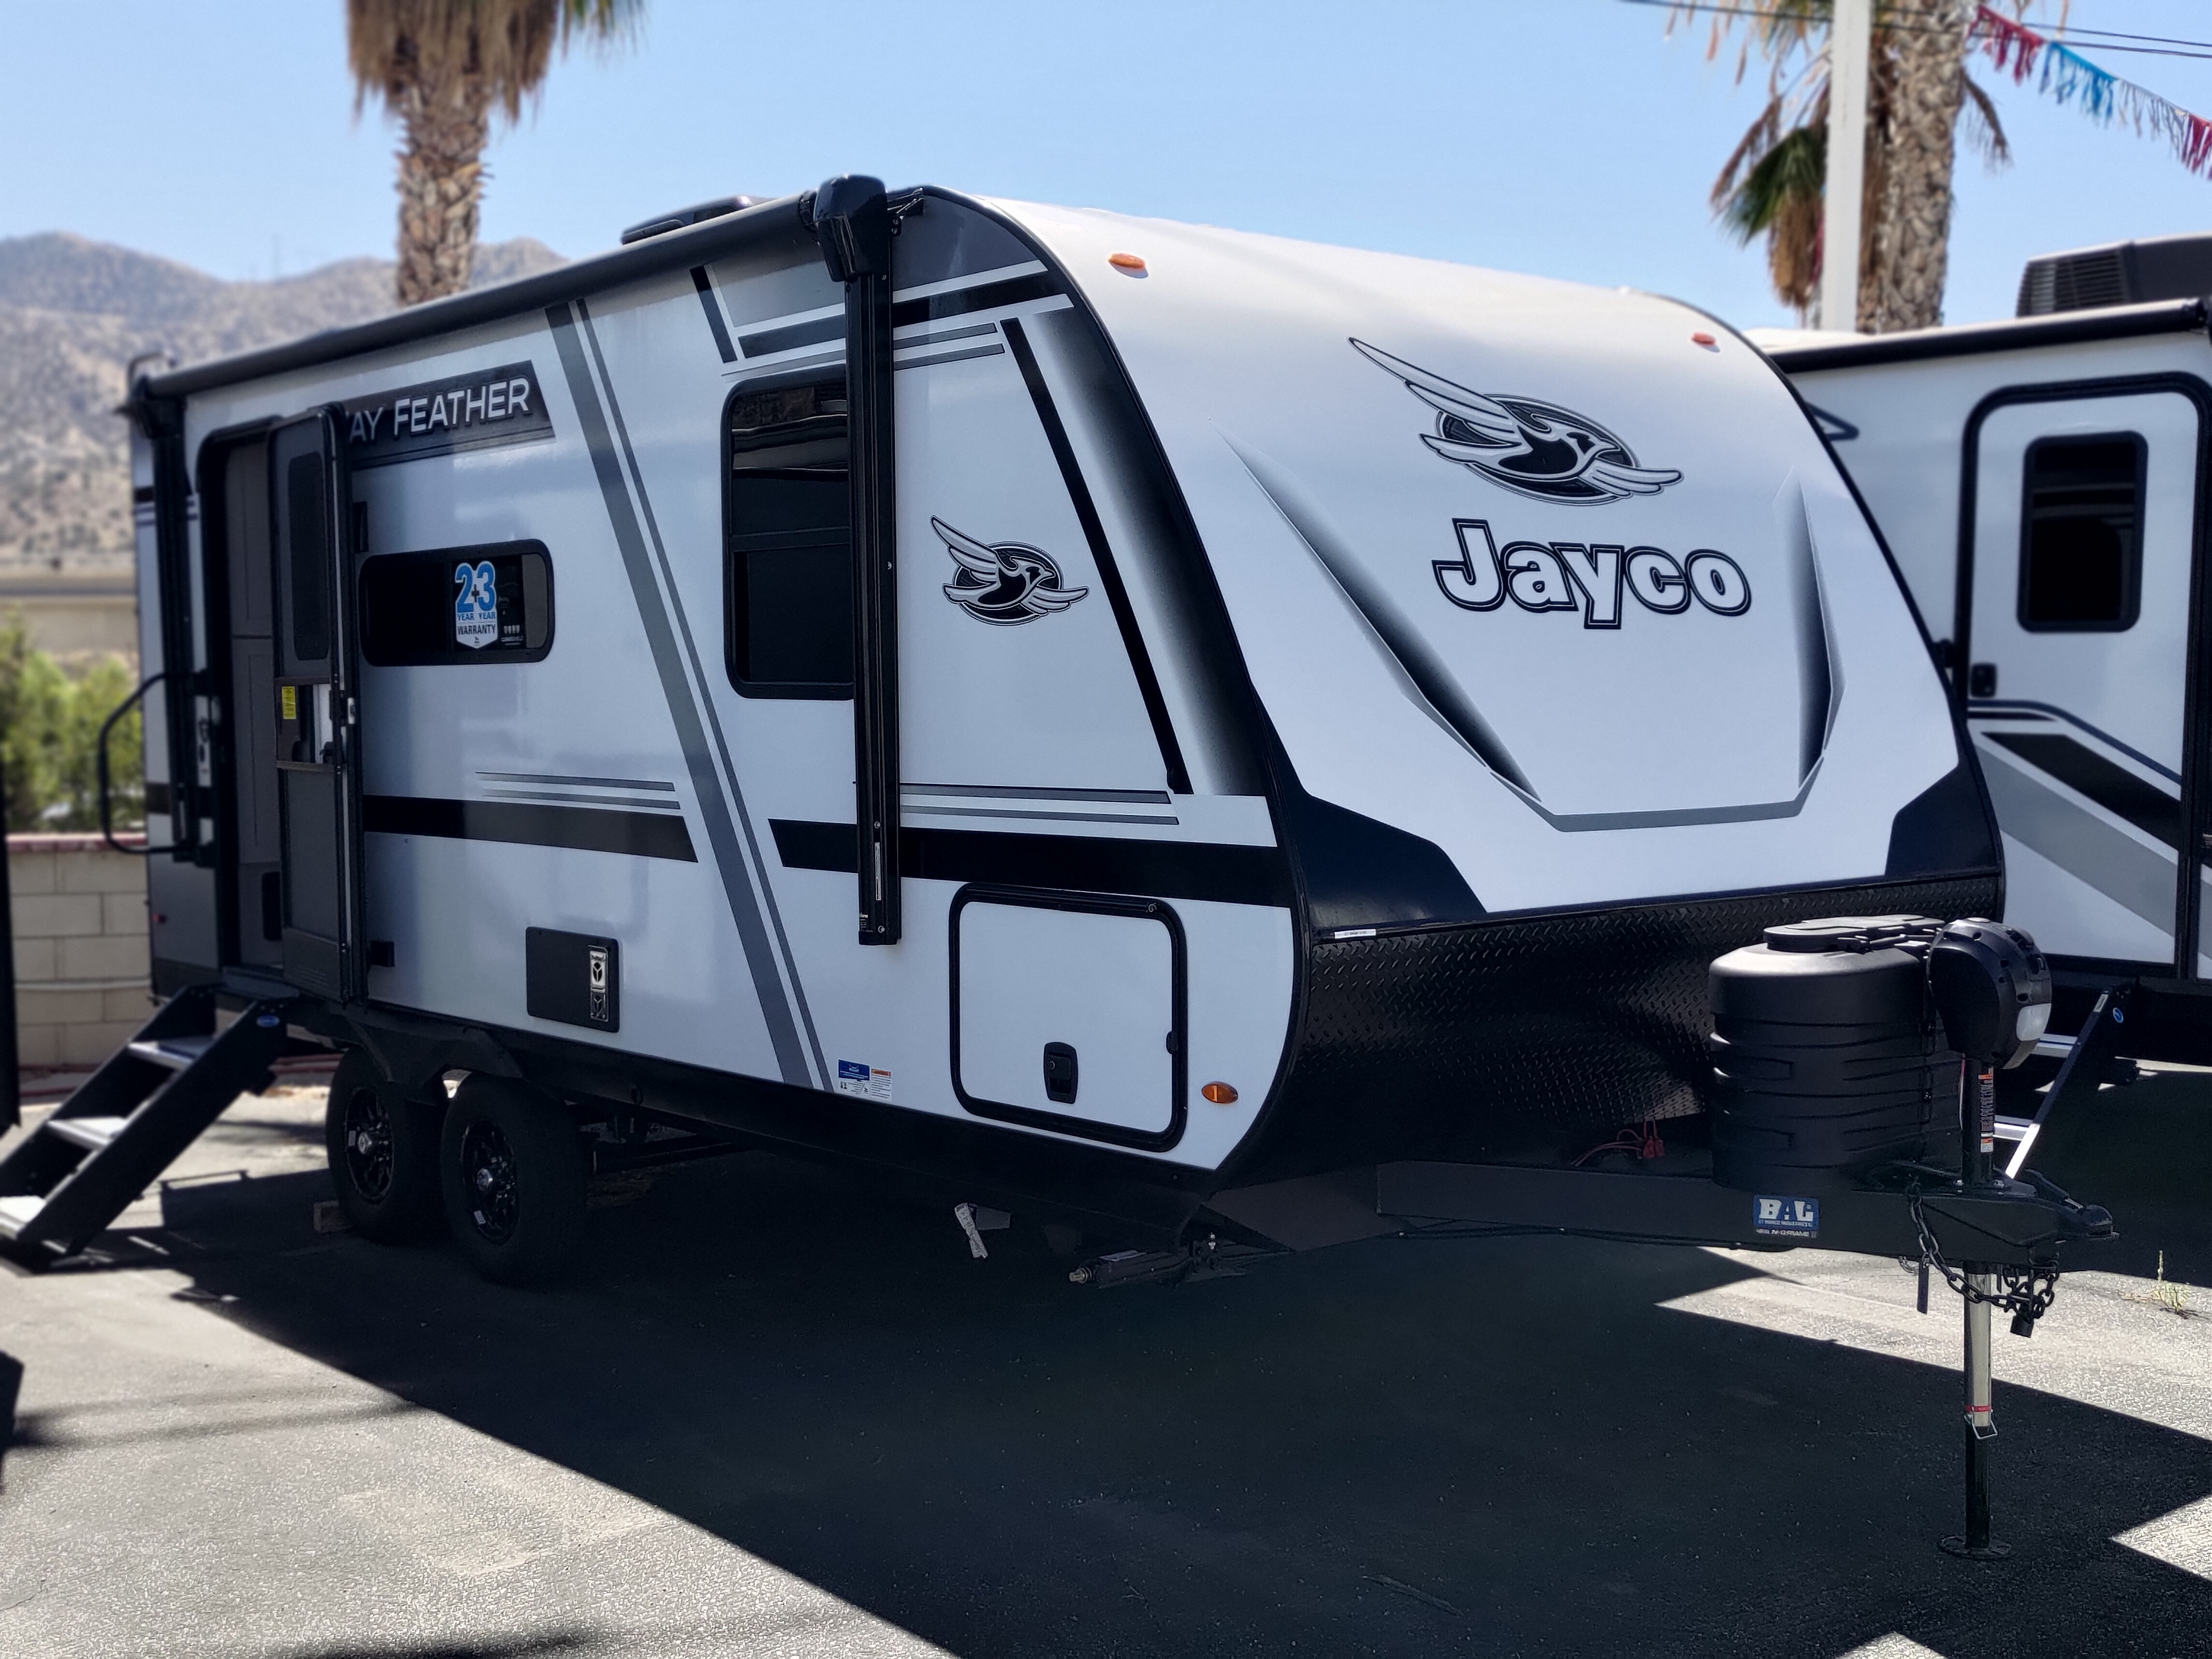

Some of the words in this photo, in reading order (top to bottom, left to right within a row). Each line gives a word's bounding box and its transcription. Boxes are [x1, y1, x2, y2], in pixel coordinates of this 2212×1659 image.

[346, 407, 384, 444] AY
[393, 377, 530, 436] FEATHER
[1431, 517, 1752, 629] Jayco
[457, 624, 495, 635] WARRANTY
[478, 611, 495, 620] YEAR
